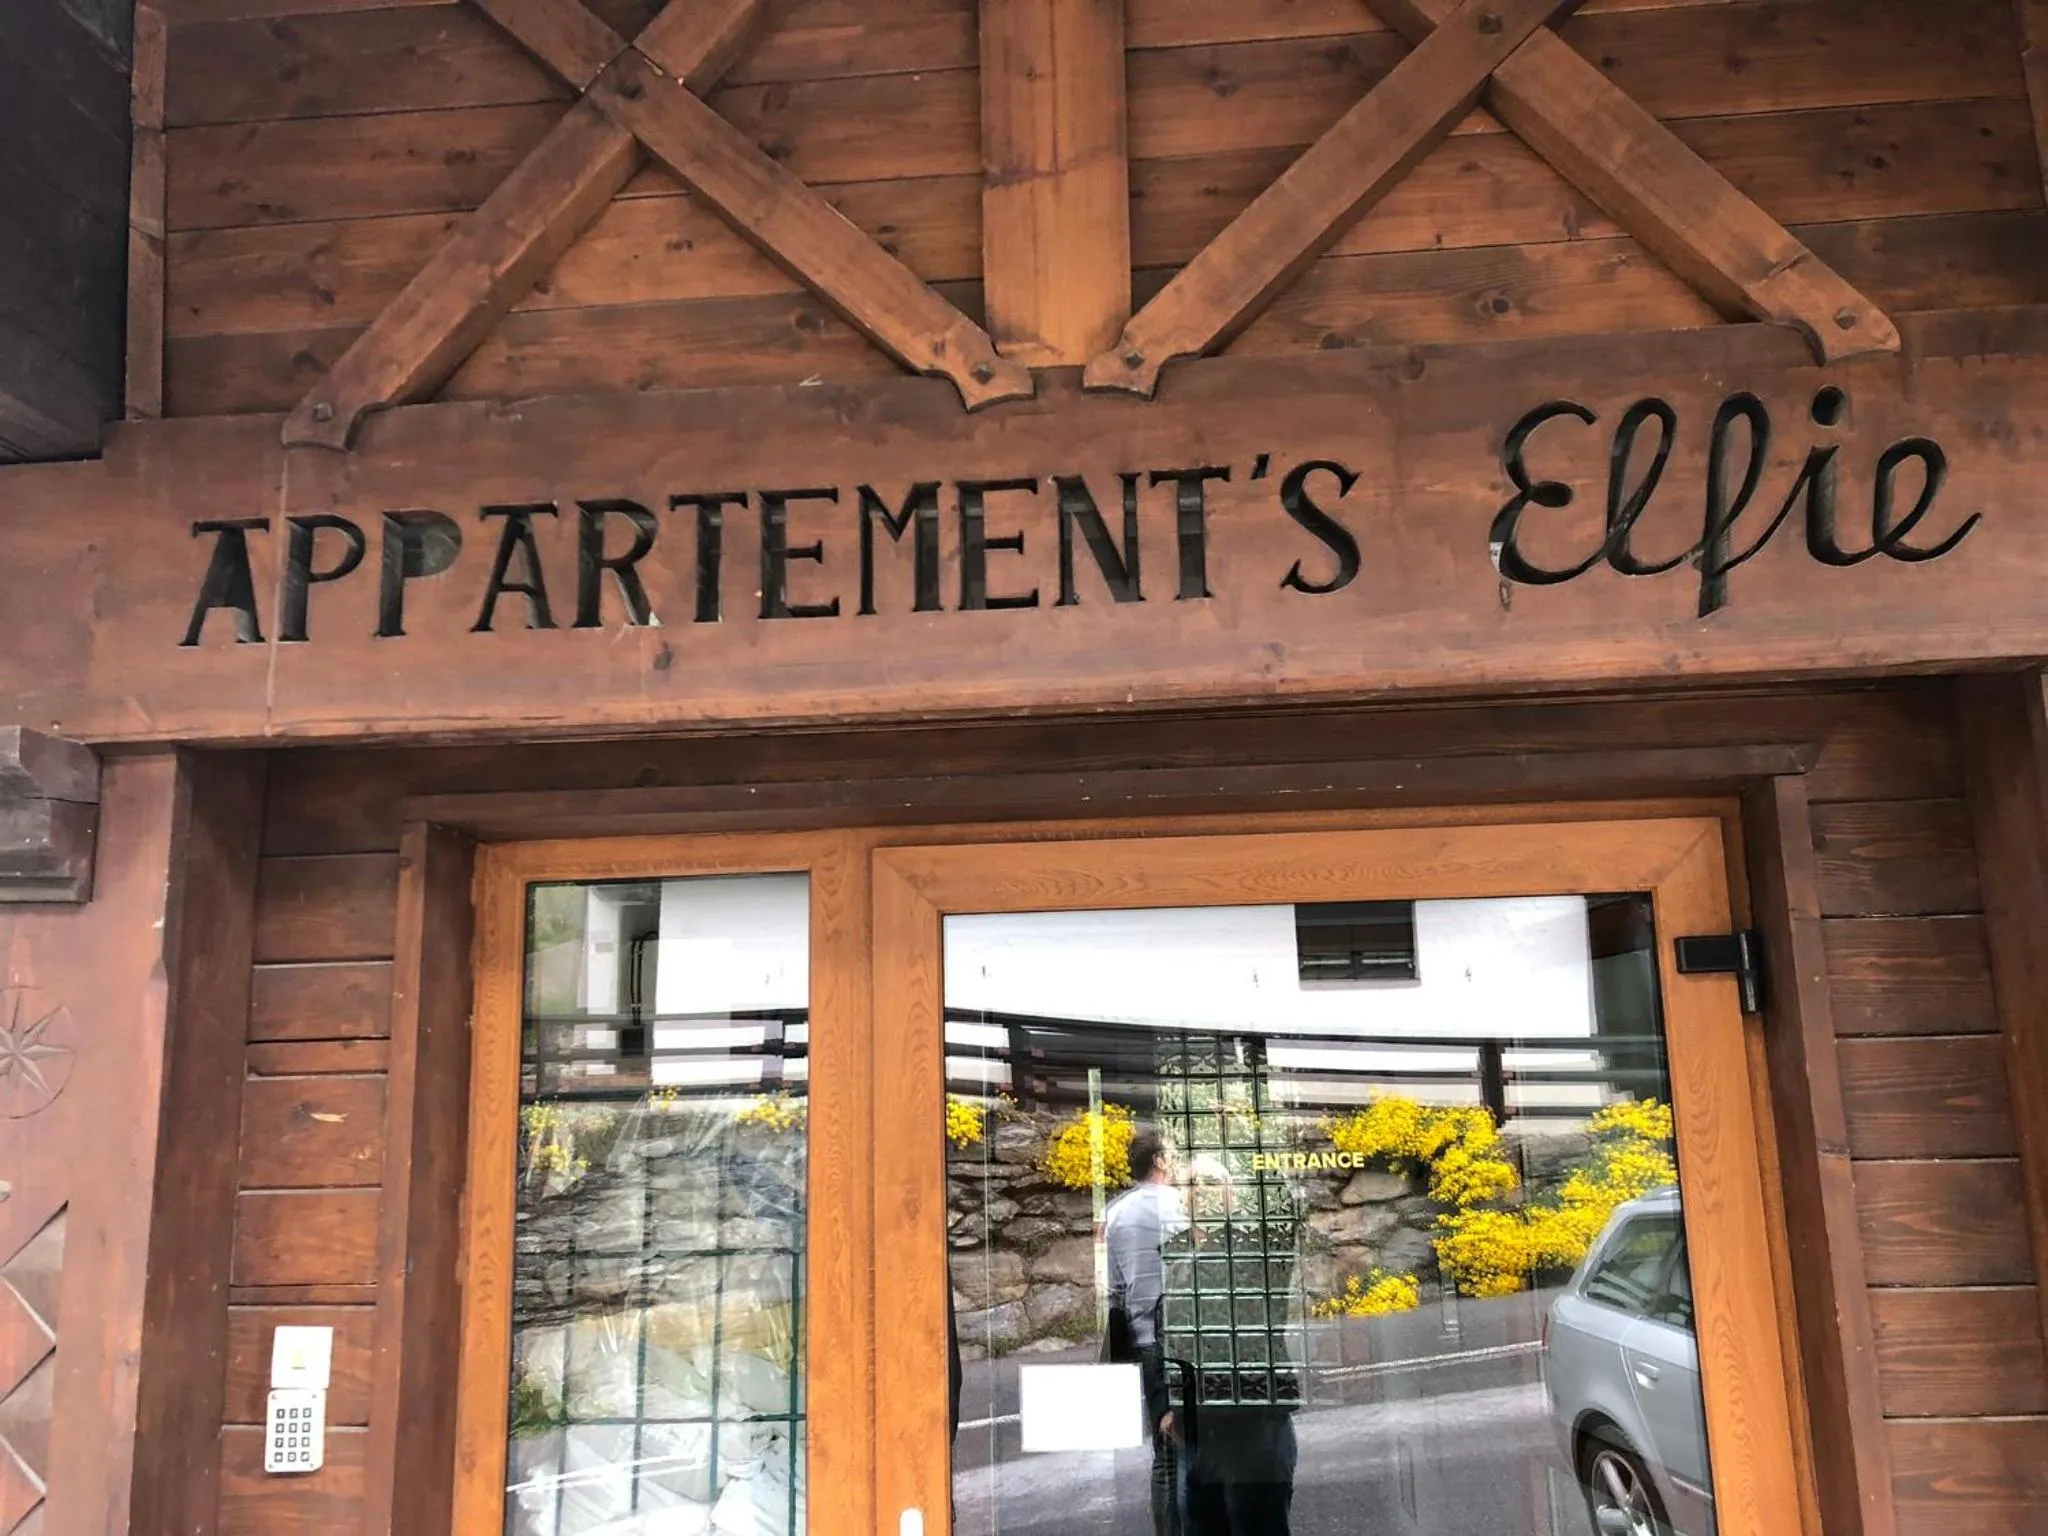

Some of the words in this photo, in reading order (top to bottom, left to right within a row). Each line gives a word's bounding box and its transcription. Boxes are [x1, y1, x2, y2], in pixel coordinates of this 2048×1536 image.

[178, 453, 1361, 646] APPARTEMENT'S
[1489, 385, 1982, 618] Elfie
[1252, 1151, 1365, 1170] ENTRANCE
